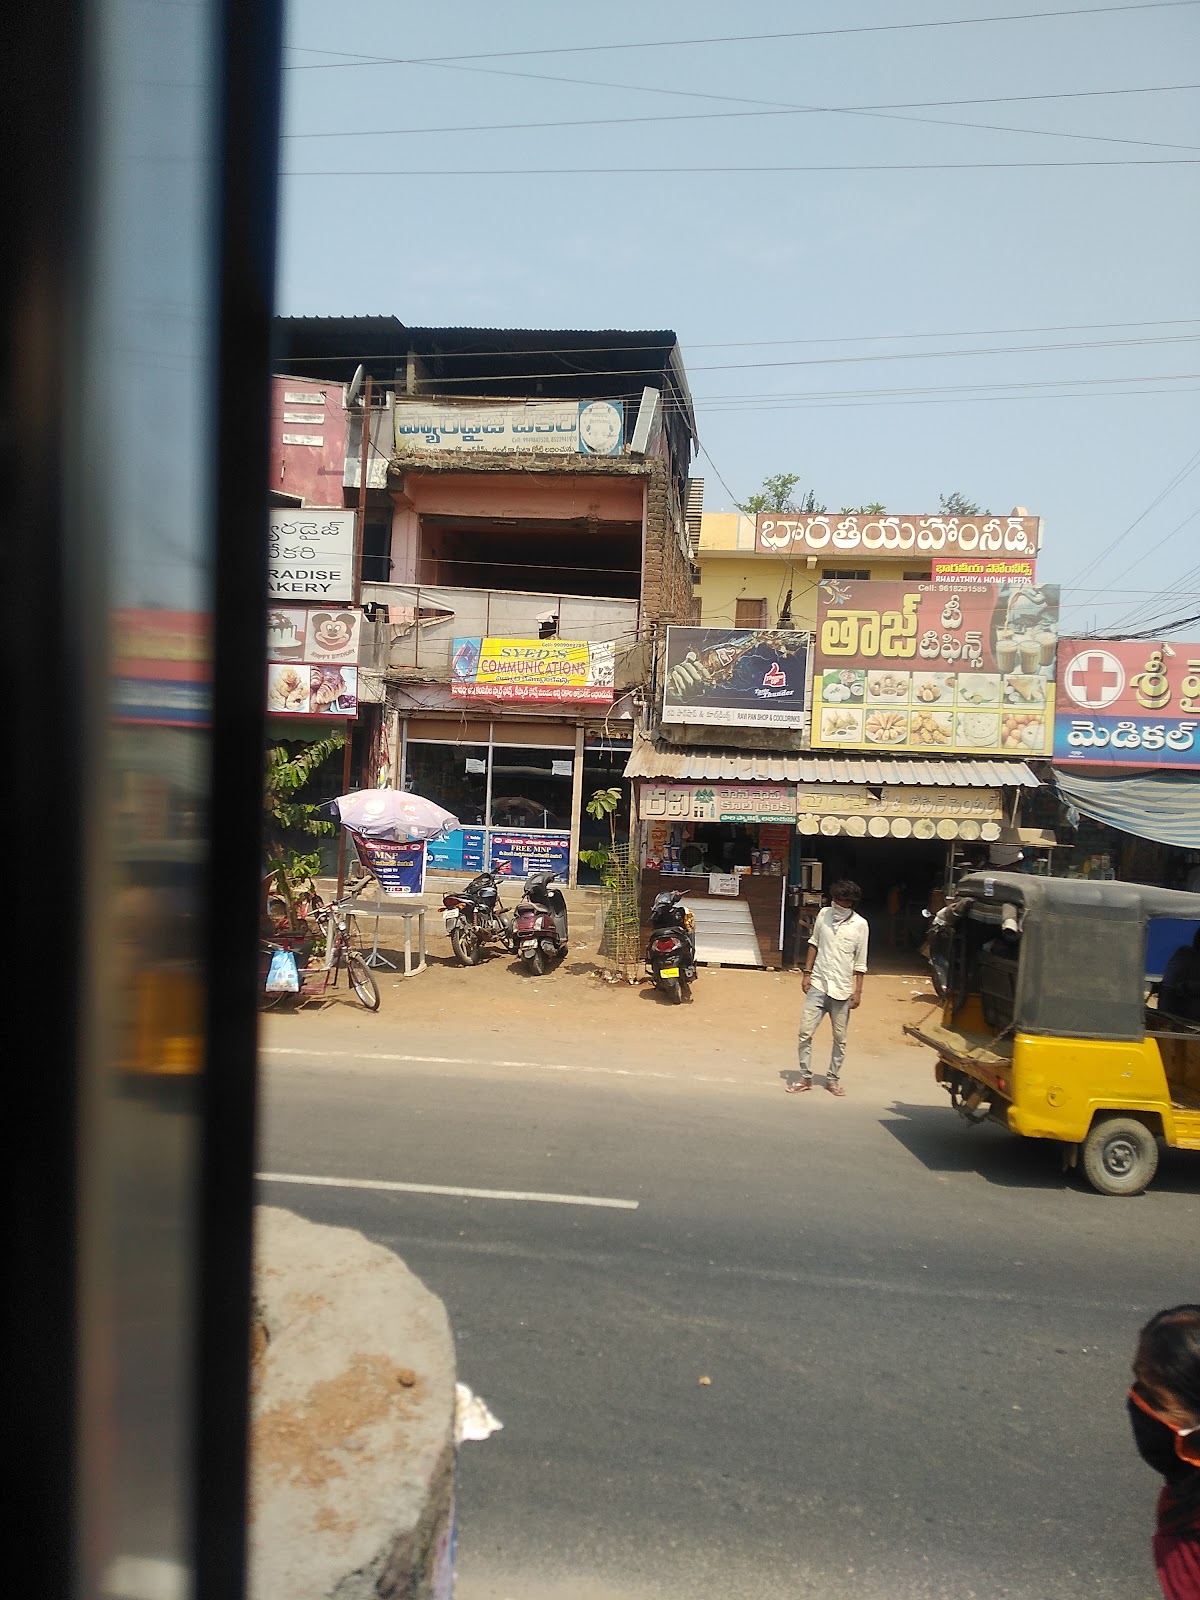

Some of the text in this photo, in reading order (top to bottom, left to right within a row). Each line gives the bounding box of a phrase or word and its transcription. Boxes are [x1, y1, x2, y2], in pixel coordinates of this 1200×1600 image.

[918, 584, 937, 592] Cell:
[983, 576, 1006, 584] HOME
[940, 595, 963, 629] టీ
[821, 593, 923, 659] తాజ్
[918, 630, 983, 668] టిఫిన్స్
[481, 659, 586, 675] COMMUNICATIONS
[1129, 651, 1172, 709] శ్రీ
[757, 713, 768, 721] SHOP
[1067, 720, 1198, 751] మెడికల్
[375, 851, 399, 859] MNP
[510, 844, 552, 853] FREE MNP
